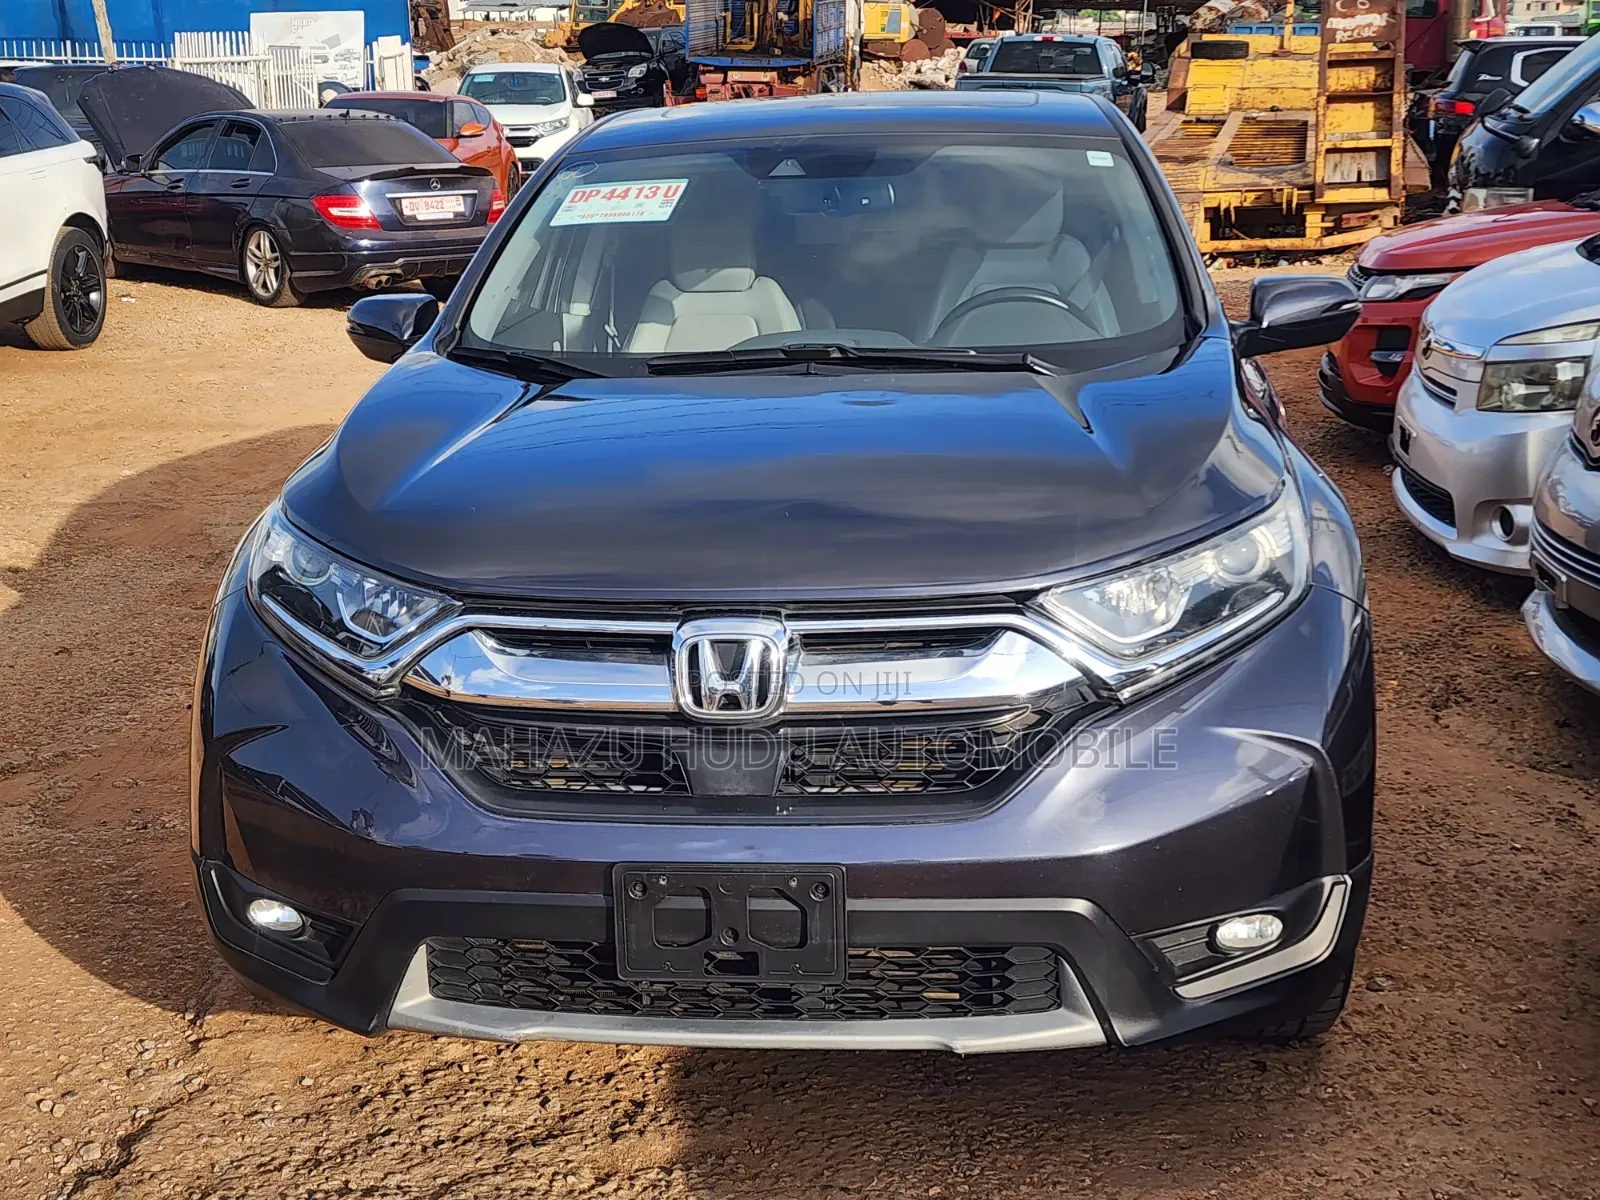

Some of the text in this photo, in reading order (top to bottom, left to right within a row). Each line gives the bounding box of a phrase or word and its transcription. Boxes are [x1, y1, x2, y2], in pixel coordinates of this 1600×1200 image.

[569, 185, 681, 204] DP 4413 U
